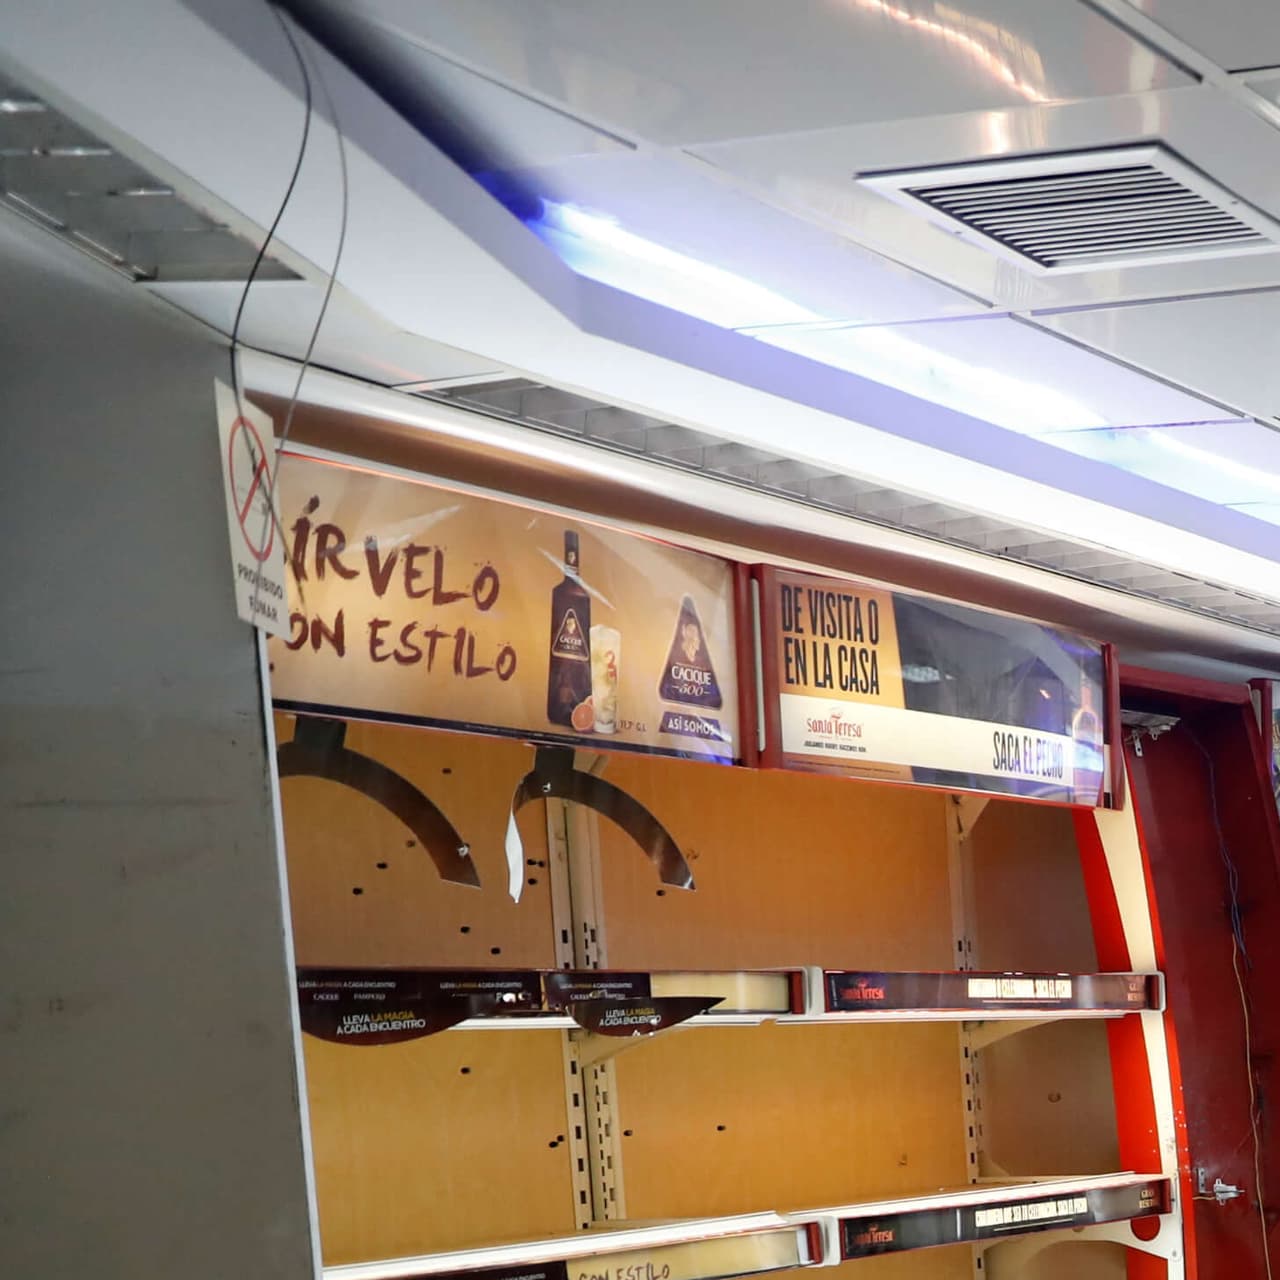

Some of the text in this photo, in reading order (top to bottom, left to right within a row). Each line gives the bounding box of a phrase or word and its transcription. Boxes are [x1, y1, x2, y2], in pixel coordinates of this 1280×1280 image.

[284, 494, 501, 612] ÍRVELO
[781, 584, 880, 646] DE VISITA O
[266, 608, 518, 681] ON ESTILO
[784, 637, 880, 695] EN LA CASA
[671, 665, 713, 686] CACIQUE
[678, 684, 705, 697] 500
[832, 713, 863, 738] Teresa
[993, 731, 1021, 772] SACA
[1023, 736, 1035, 775] EL
[344, 1022, 370, 1034] CADA
[370, 1018, 426, 1033] ENCUENTRO
